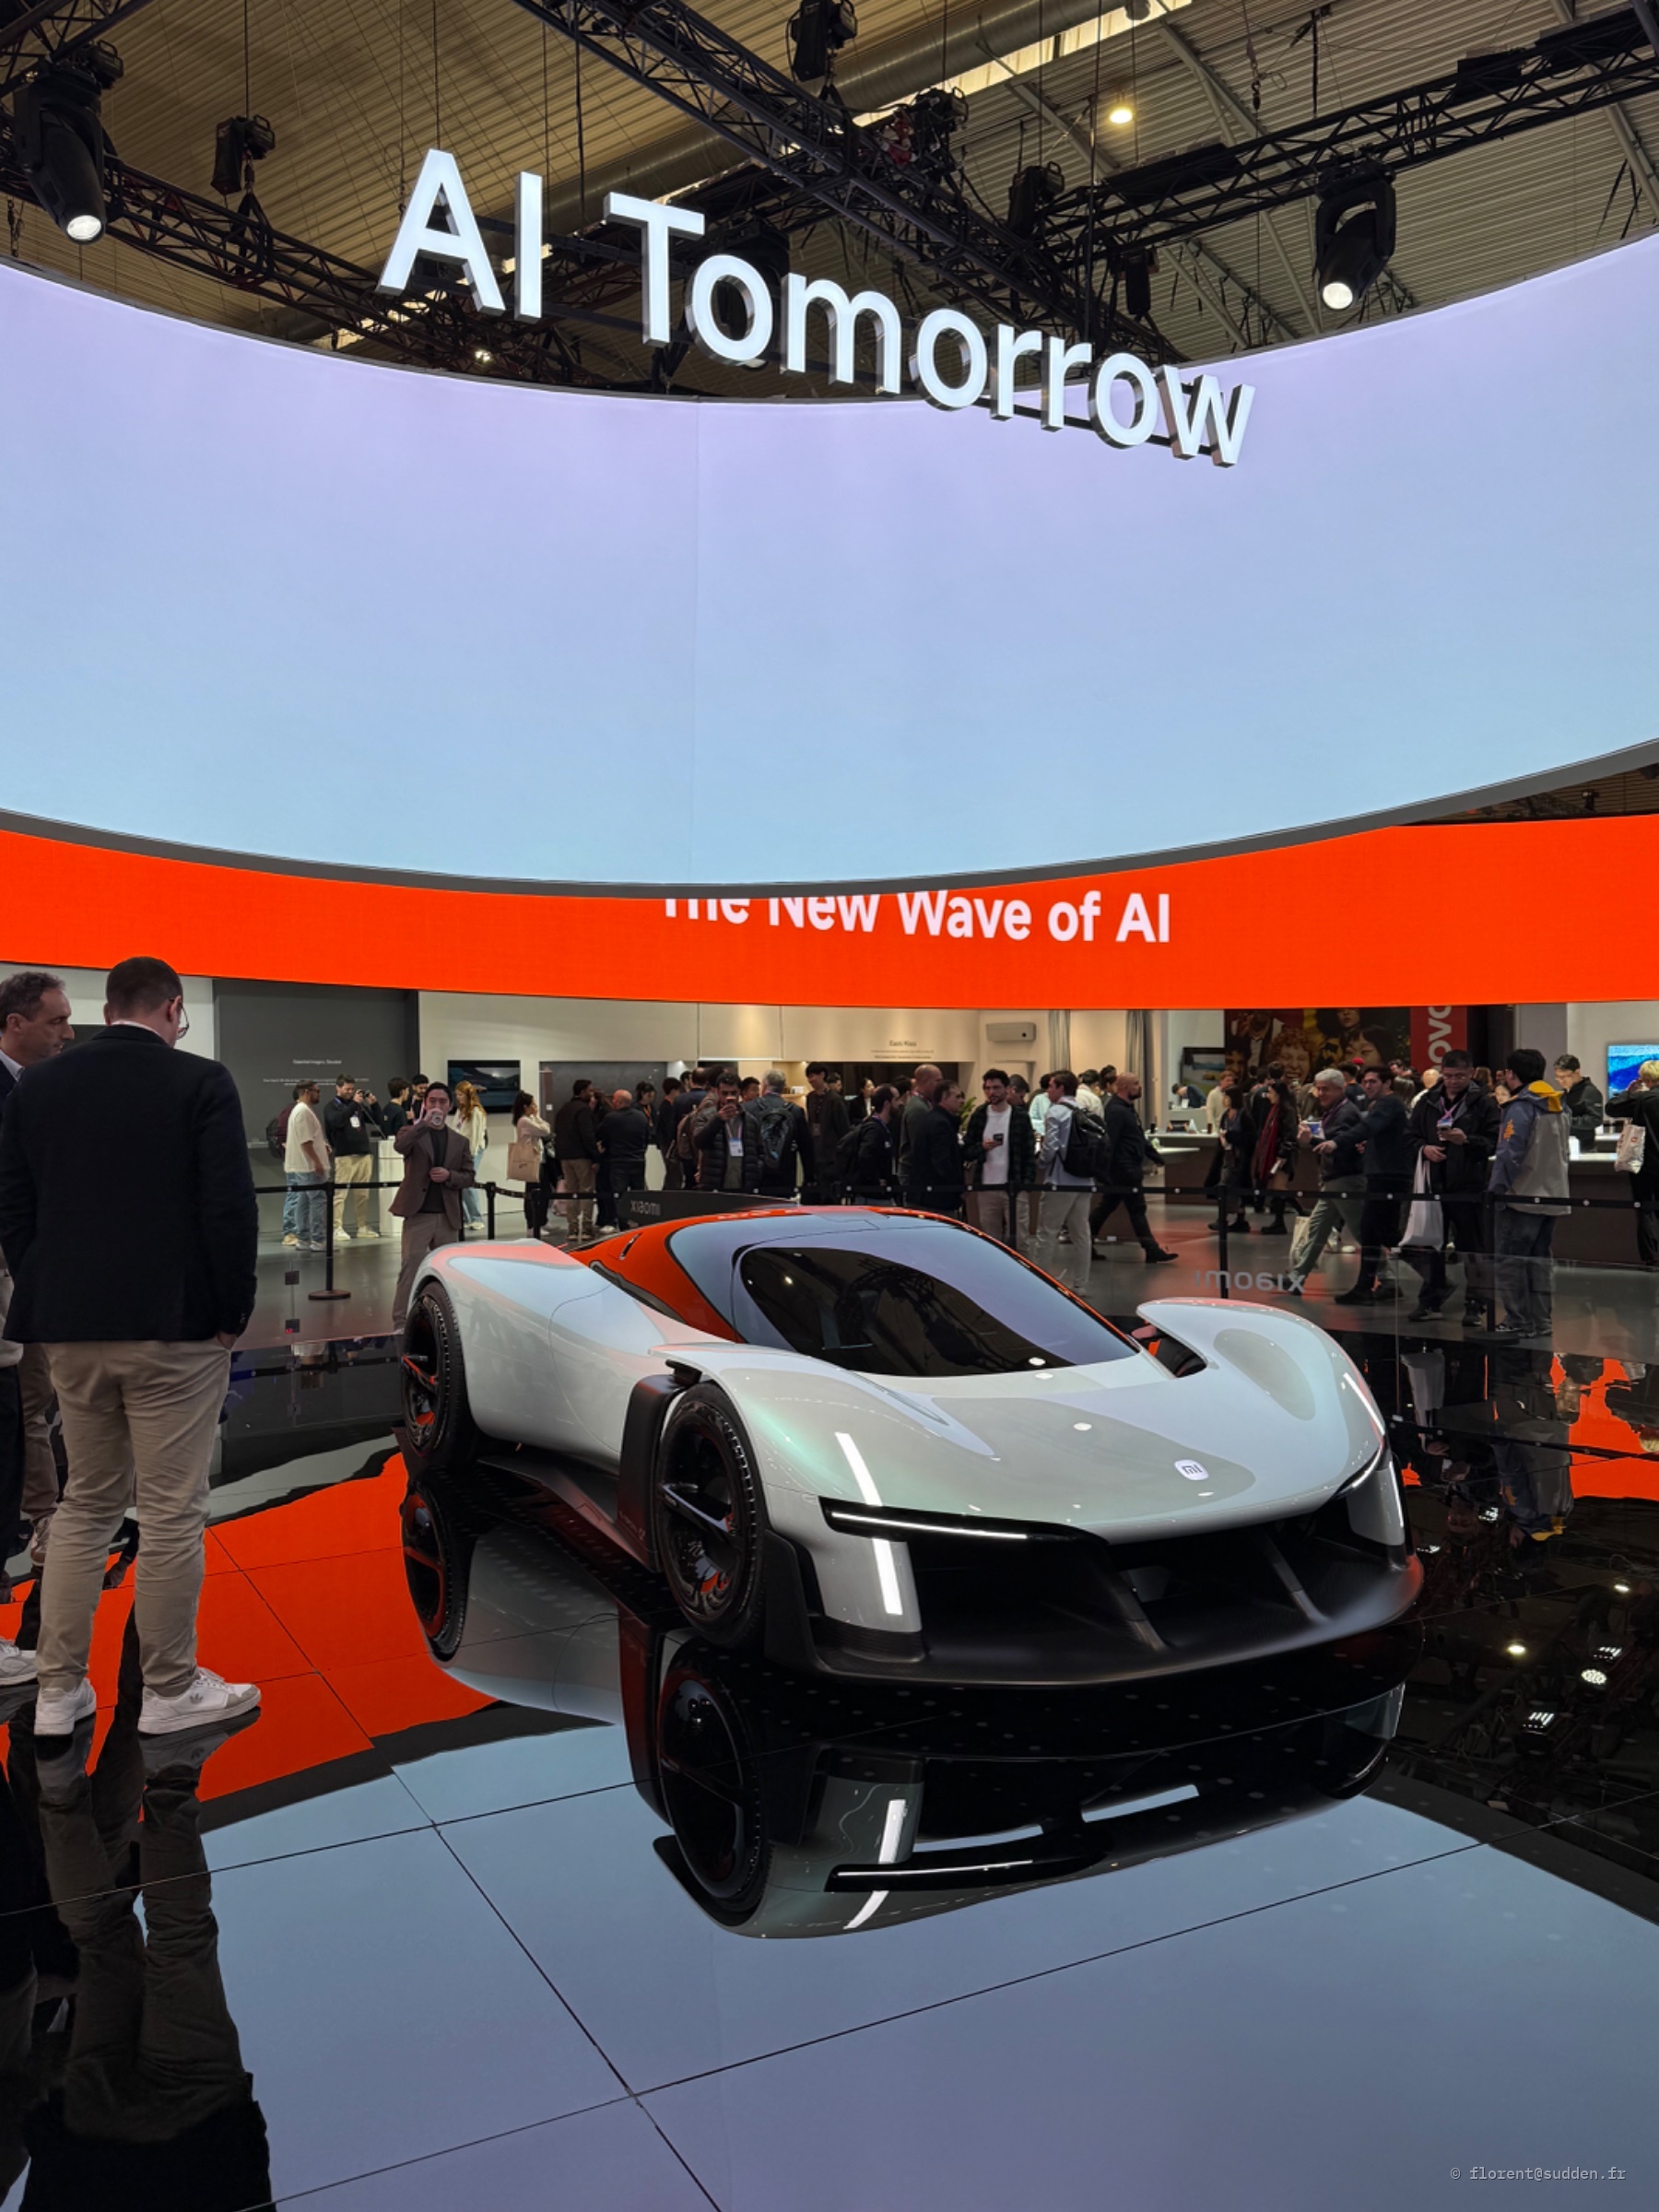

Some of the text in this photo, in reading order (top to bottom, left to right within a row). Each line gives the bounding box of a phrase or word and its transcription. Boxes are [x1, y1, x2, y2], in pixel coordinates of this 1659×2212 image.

[378, 148, 1255, 467] AI Tomorrow
[769, 894, 879, 933] New
[897, 889, 1031, 940] Wave
[1047, 891, 1101, 942] of
[1115, 893, 1170, 943] AI
[1428, 1006, 1453, 1072] ovo
